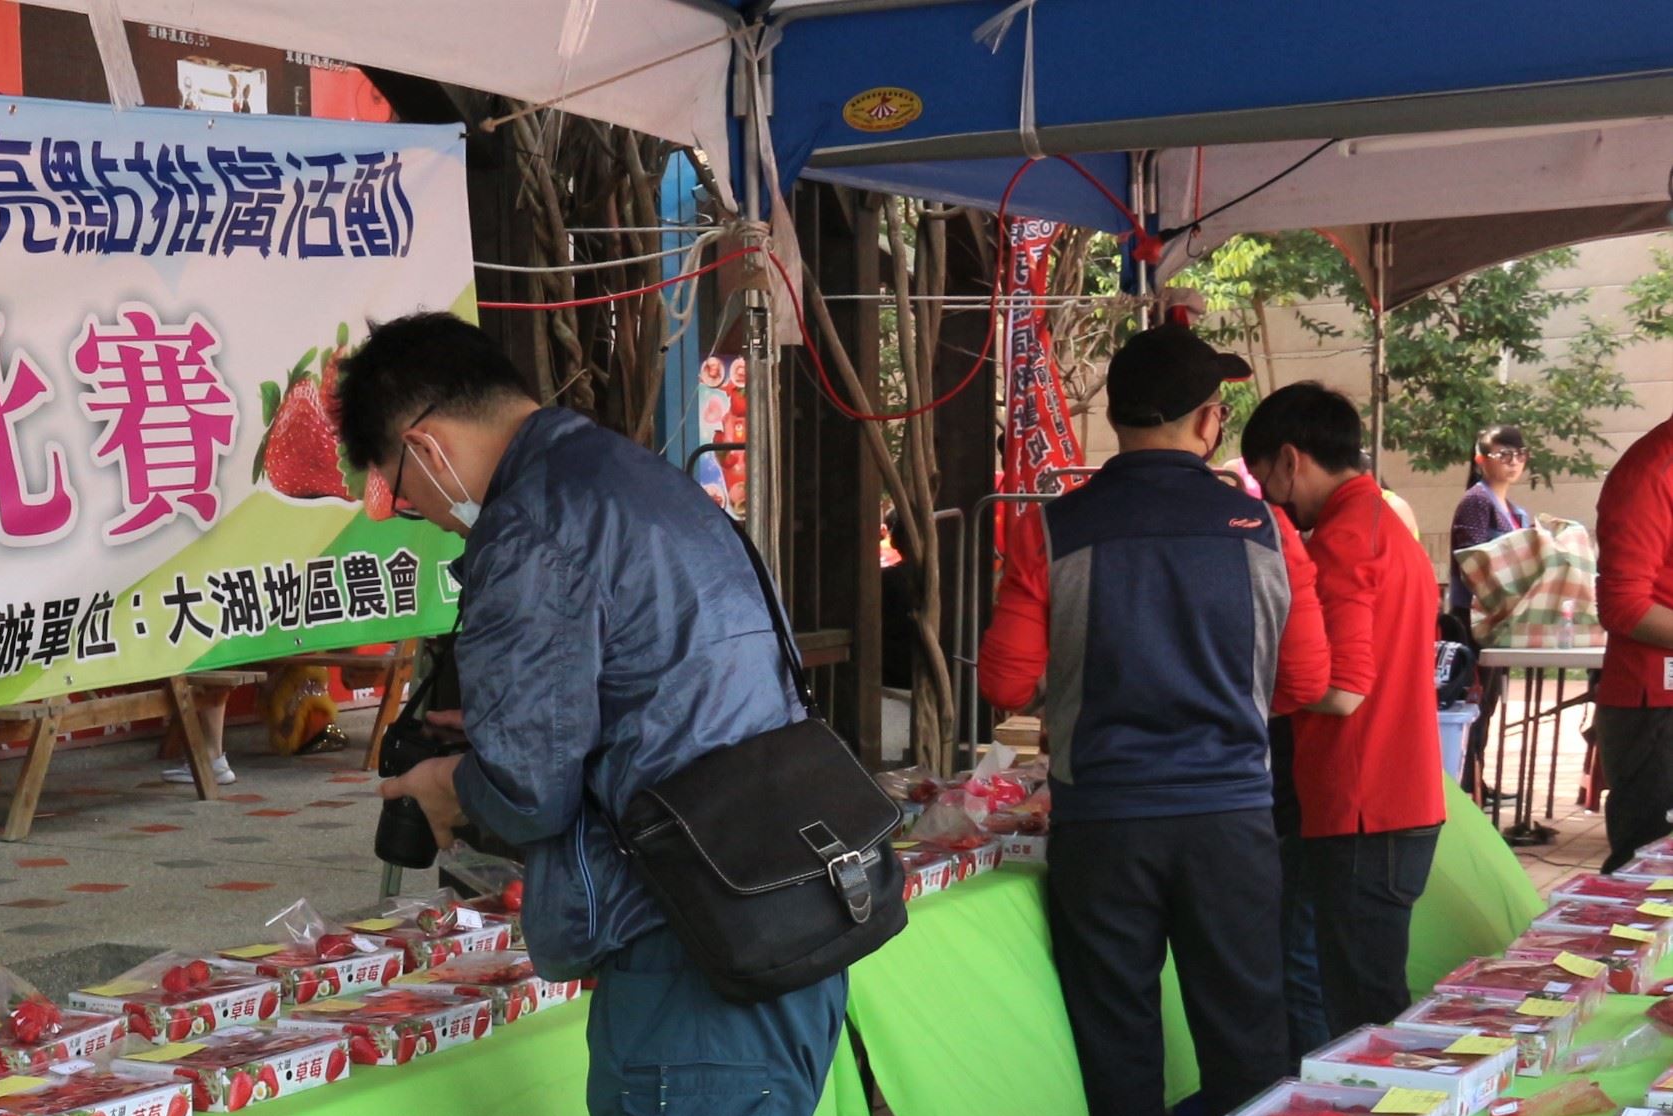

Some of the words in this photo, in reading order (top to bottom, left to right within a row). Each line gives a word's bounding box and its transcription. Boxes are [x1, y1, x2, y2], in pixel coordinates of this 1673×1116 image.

[230, 998, 255, 1021] 草莓
[449, 1015, 472, 1038] 草莓
[294, 1057, 323, 1083] 草莓
